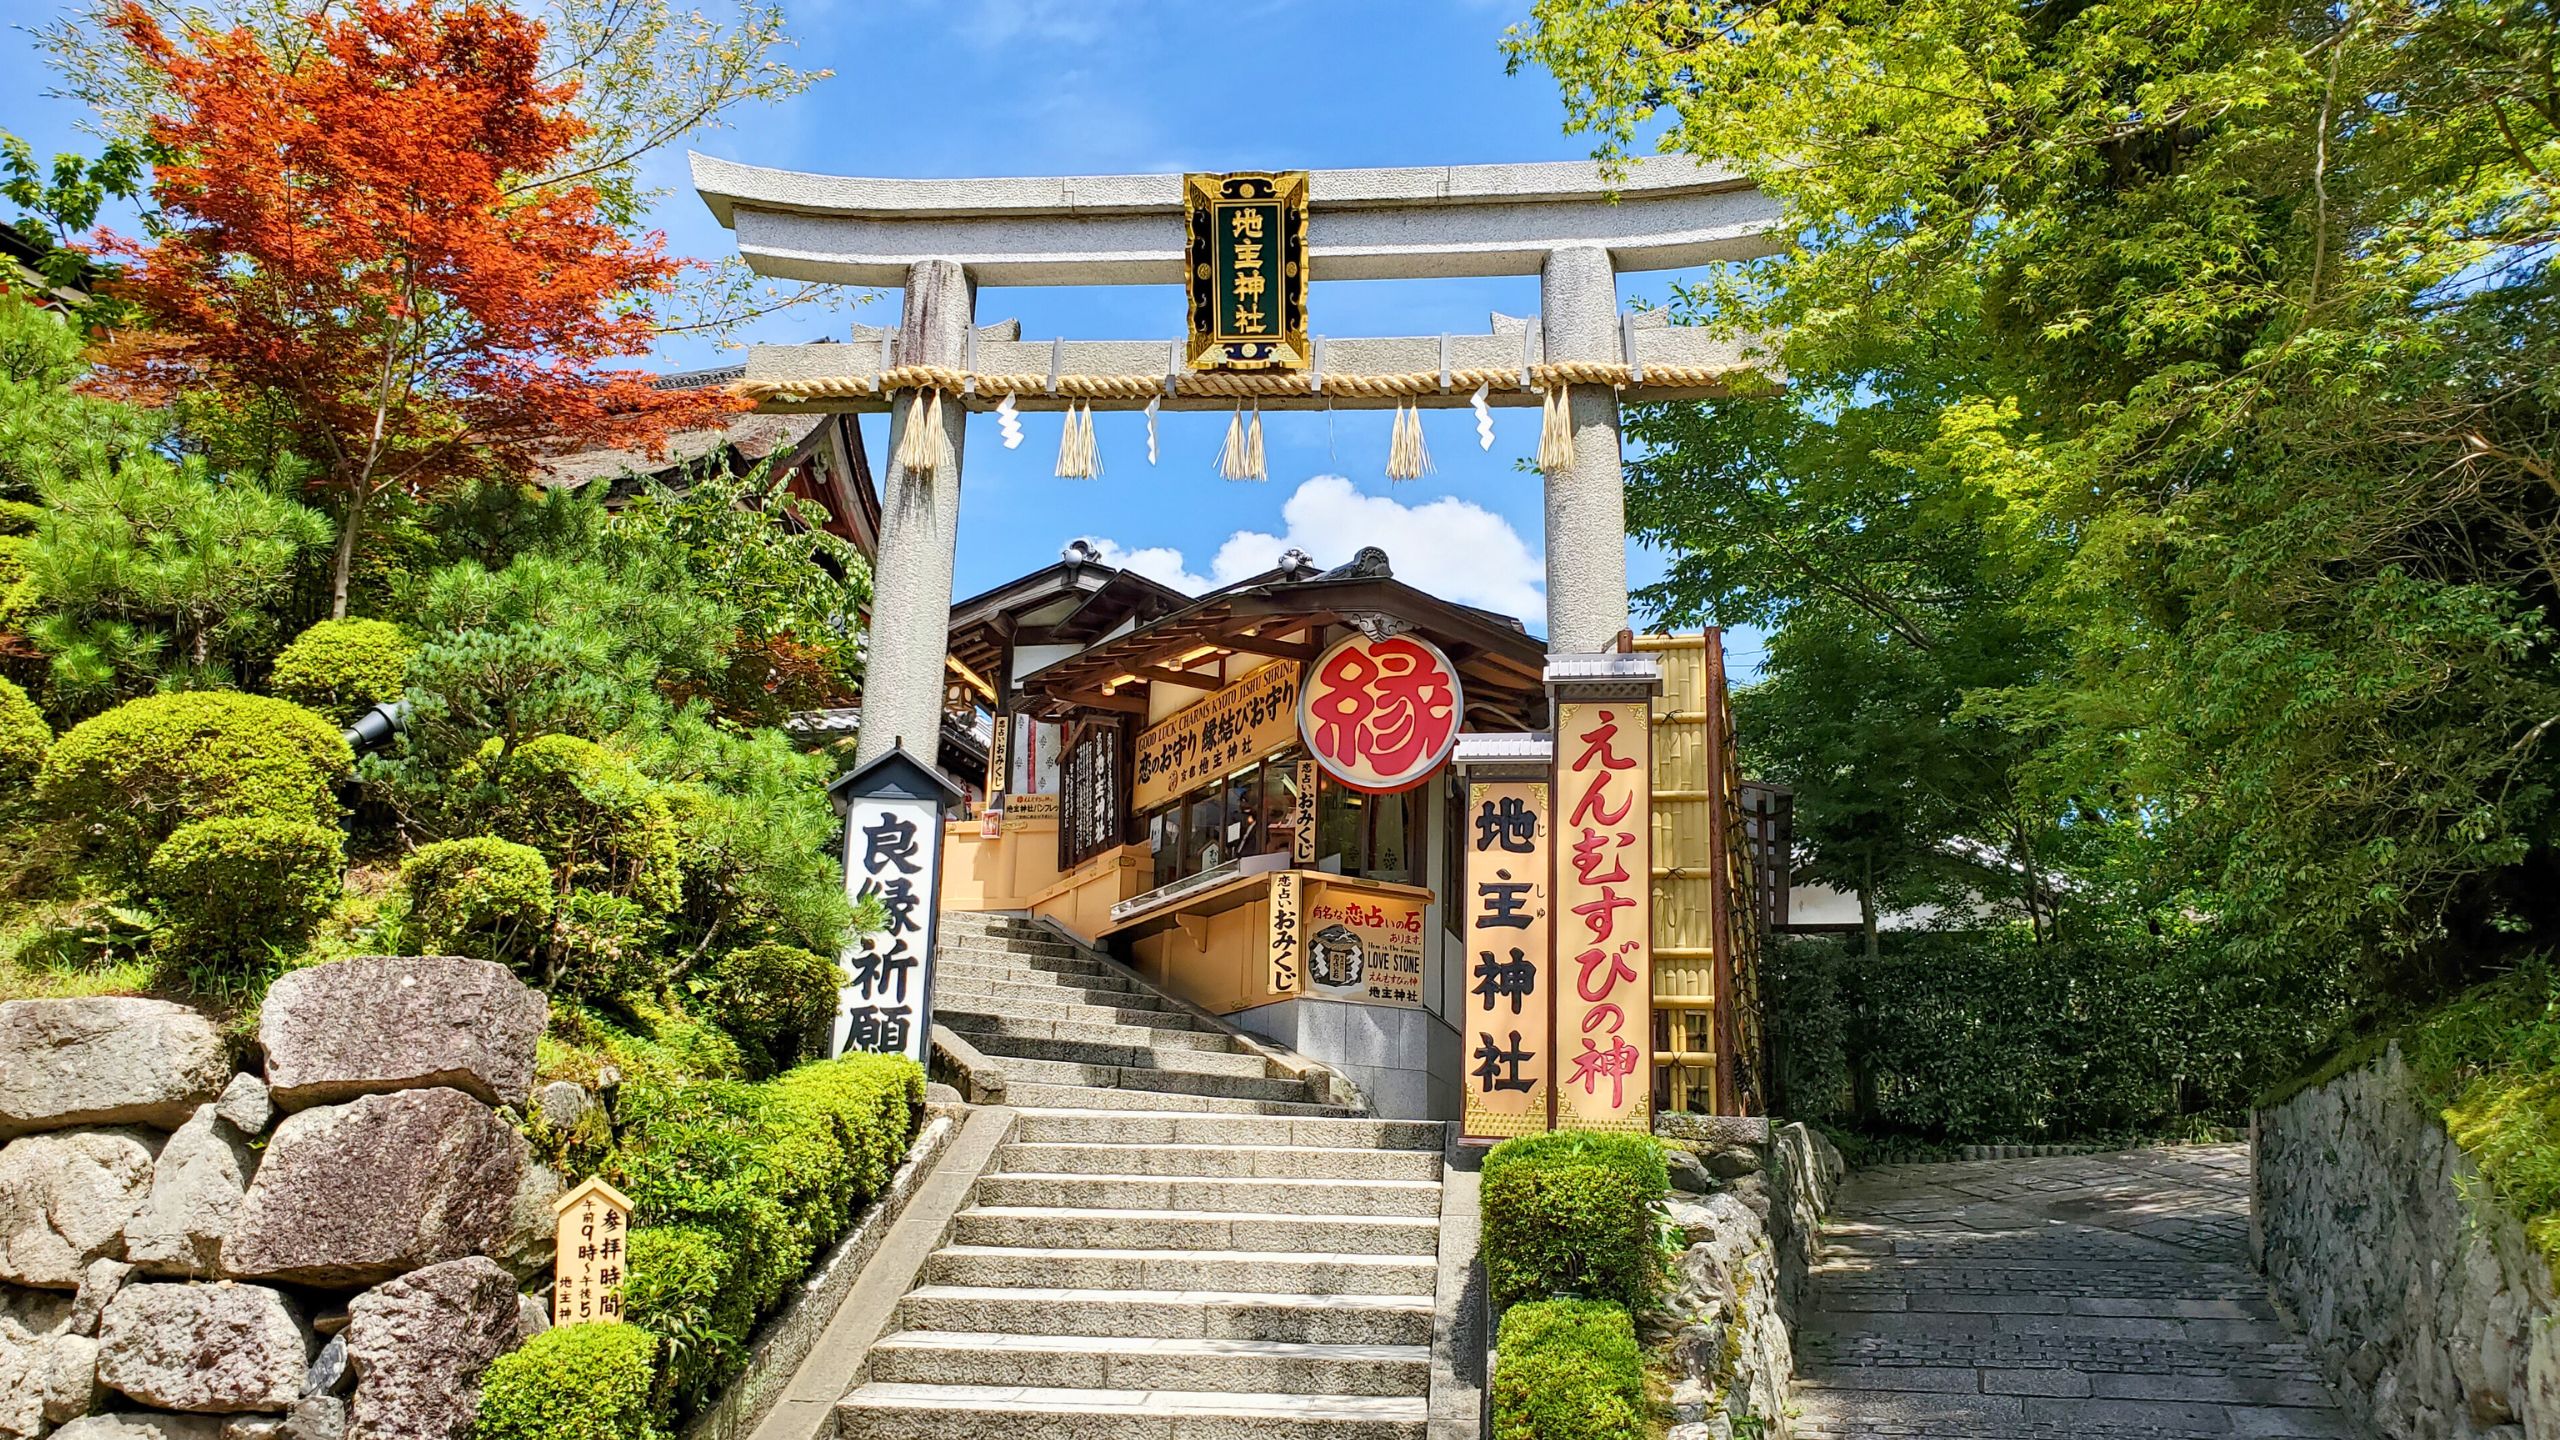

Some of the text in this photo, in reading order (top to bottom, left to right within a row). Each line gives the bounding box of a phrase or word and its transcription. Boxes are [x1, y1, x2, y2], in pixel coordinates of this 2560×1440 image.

[1231, 207, 1267, 334] 地主神社
[1137, 729, 1197, 786] 恋のお守り
[1201, 679, 1294, 753] 縁結びお守り
[1138, 660, 1295, 752] GOOD LUCK CHARMS KYOTO JISHU SHRINE
[1311, 638, 1453, 776] 縁
[1296, 762, 1314, 859] 恋占いおみくじ
[842, 812, 922, 1052] 良縁祈願
[1272, 875, 1297, 992] 恋占いおみくじ
[1312, 902, 1421, 933] 有名な恋占いの石
[1368, 951, 1420, 974] LOVE STONE
[1471, 796, 1539, 1094] 地主神社
[1565, 710, 1639, 1109] えんむすびの神
[1368, 986, 1418, 1002] 地主神社
[559, 1276, 572, 1328] 地主神
[578, 1199, 599, 1324] 午前9時〜午後5
[599, 1208, 622, 1317] 参拝時間
